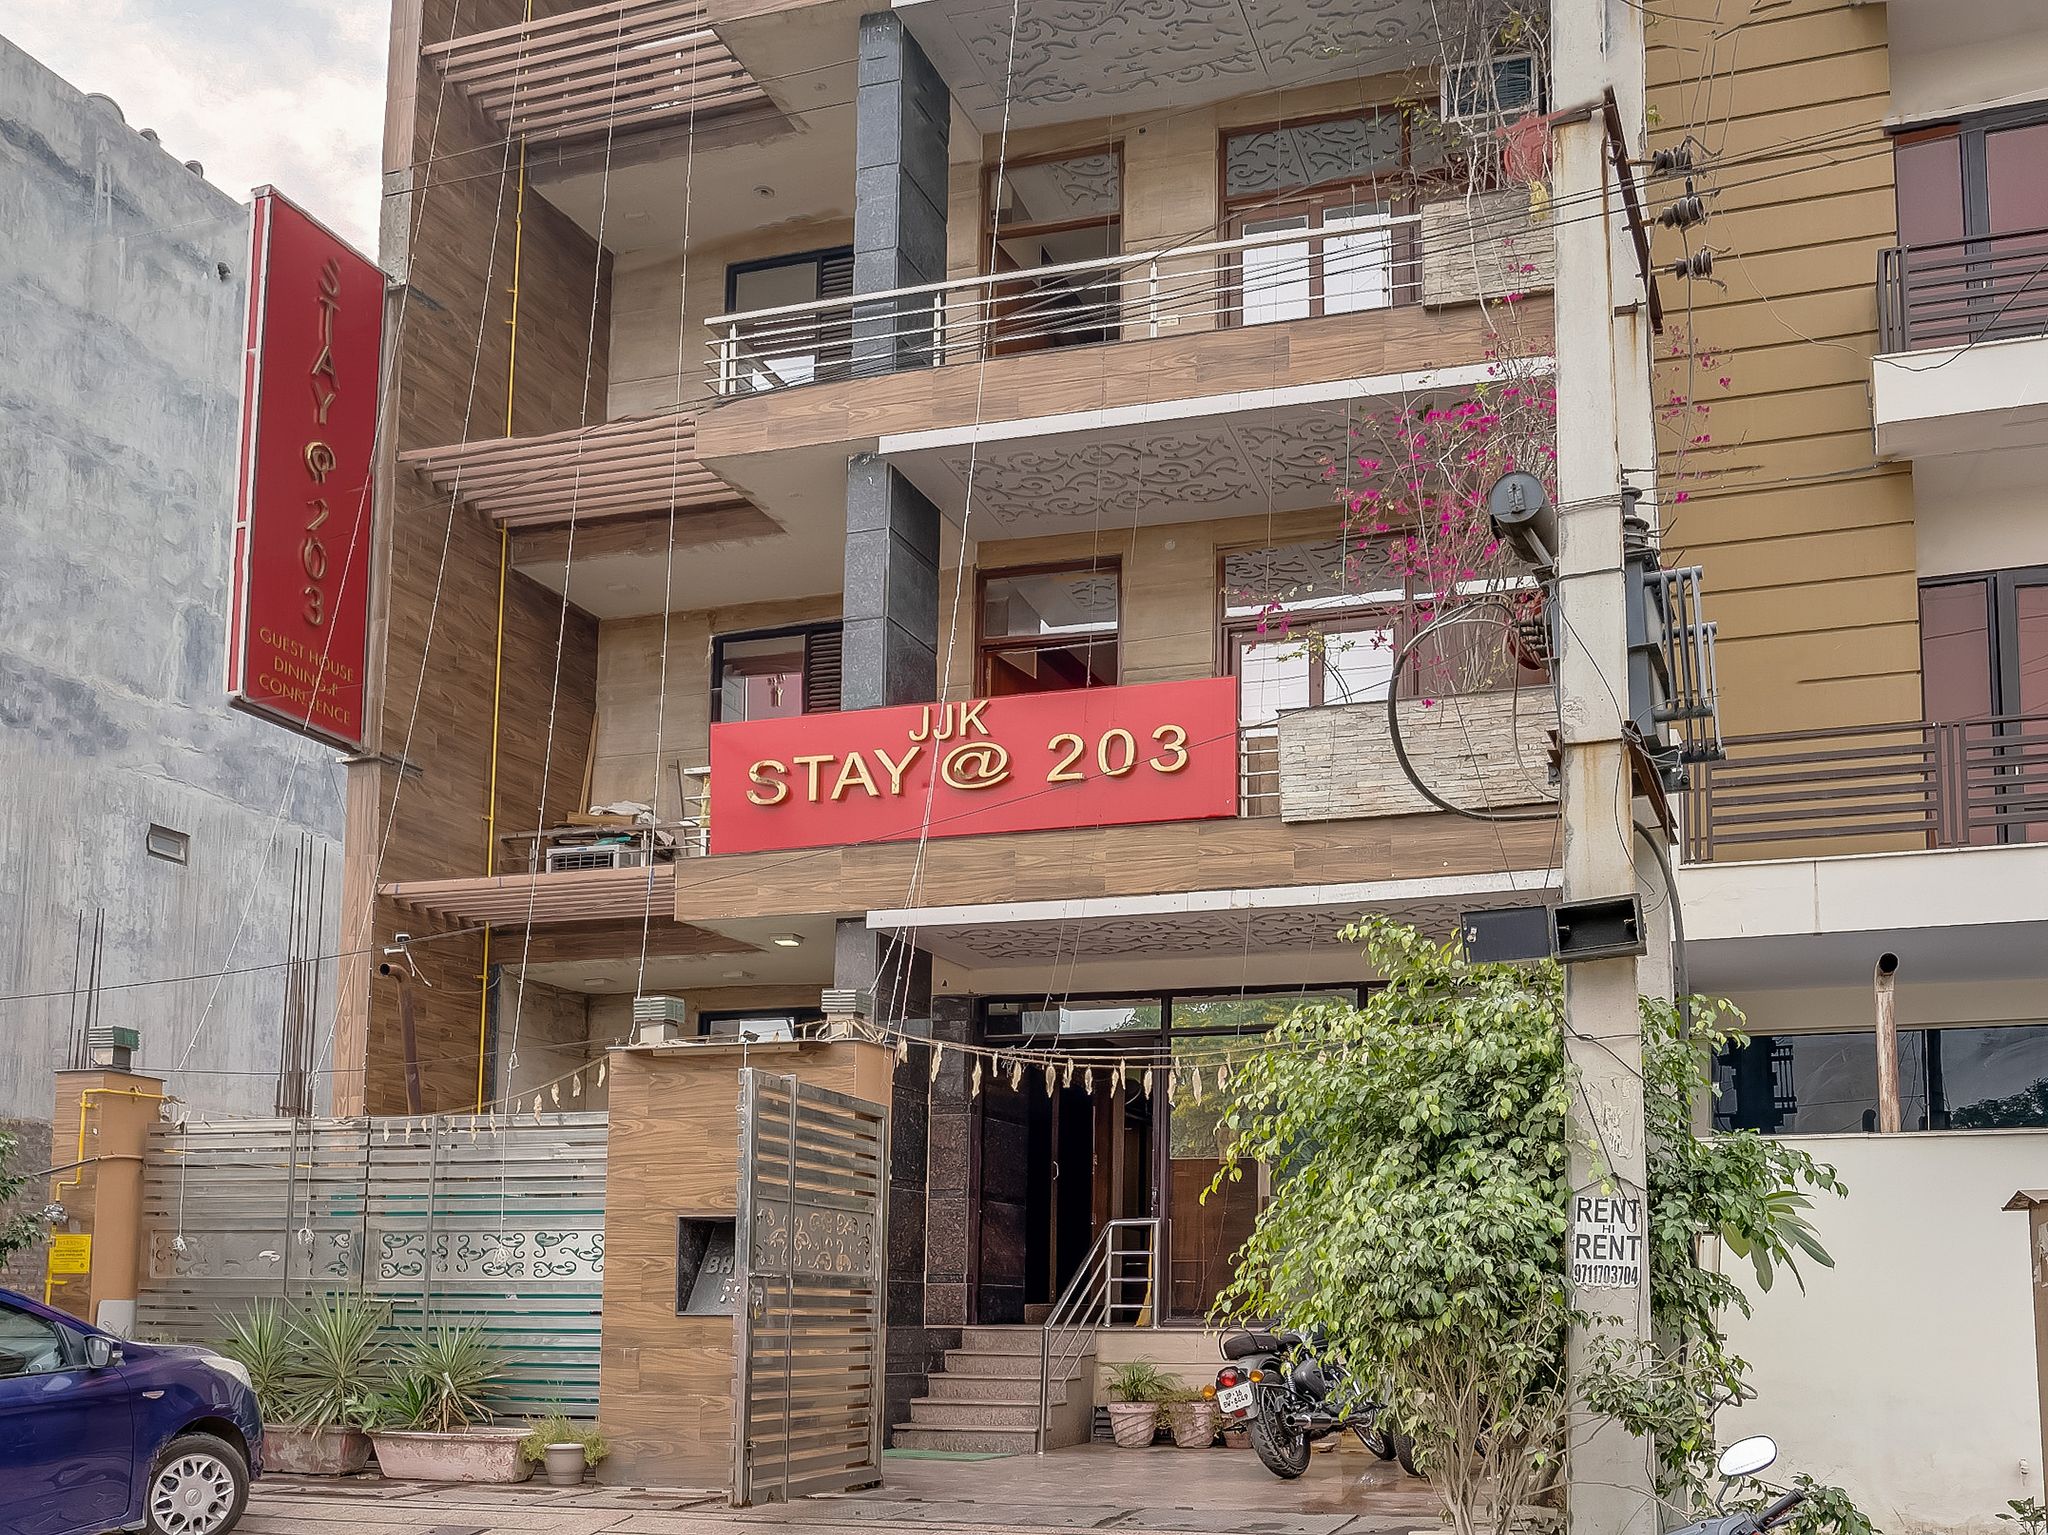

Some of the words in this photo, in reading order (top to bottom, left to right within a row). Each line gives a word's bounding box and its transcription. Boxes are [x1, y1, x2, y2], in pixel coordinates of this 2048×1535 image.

[311, 256, 342, 425] STAY
[303, 441, 337, 484] @
[302, 498, 330, 626] 203
[259, 626, 305, 659] GUEST
[309, 649, 354, 682] HOUSE
[273, 655, 326, 693] DINING
[908, 700, 992, 743] JJK
[745, 746, 922, 807] STAY
[940, 741, 1011, 790] @
[1046, 724, 1190, 784] 203
[1576, 1197, 1641, 1224] RENT
[1602, 1224, 1615, 1234] HI
[1575, 1233, 1641, 1261] RENT
[1574, 1263, 1639, 1285] 9711703704
